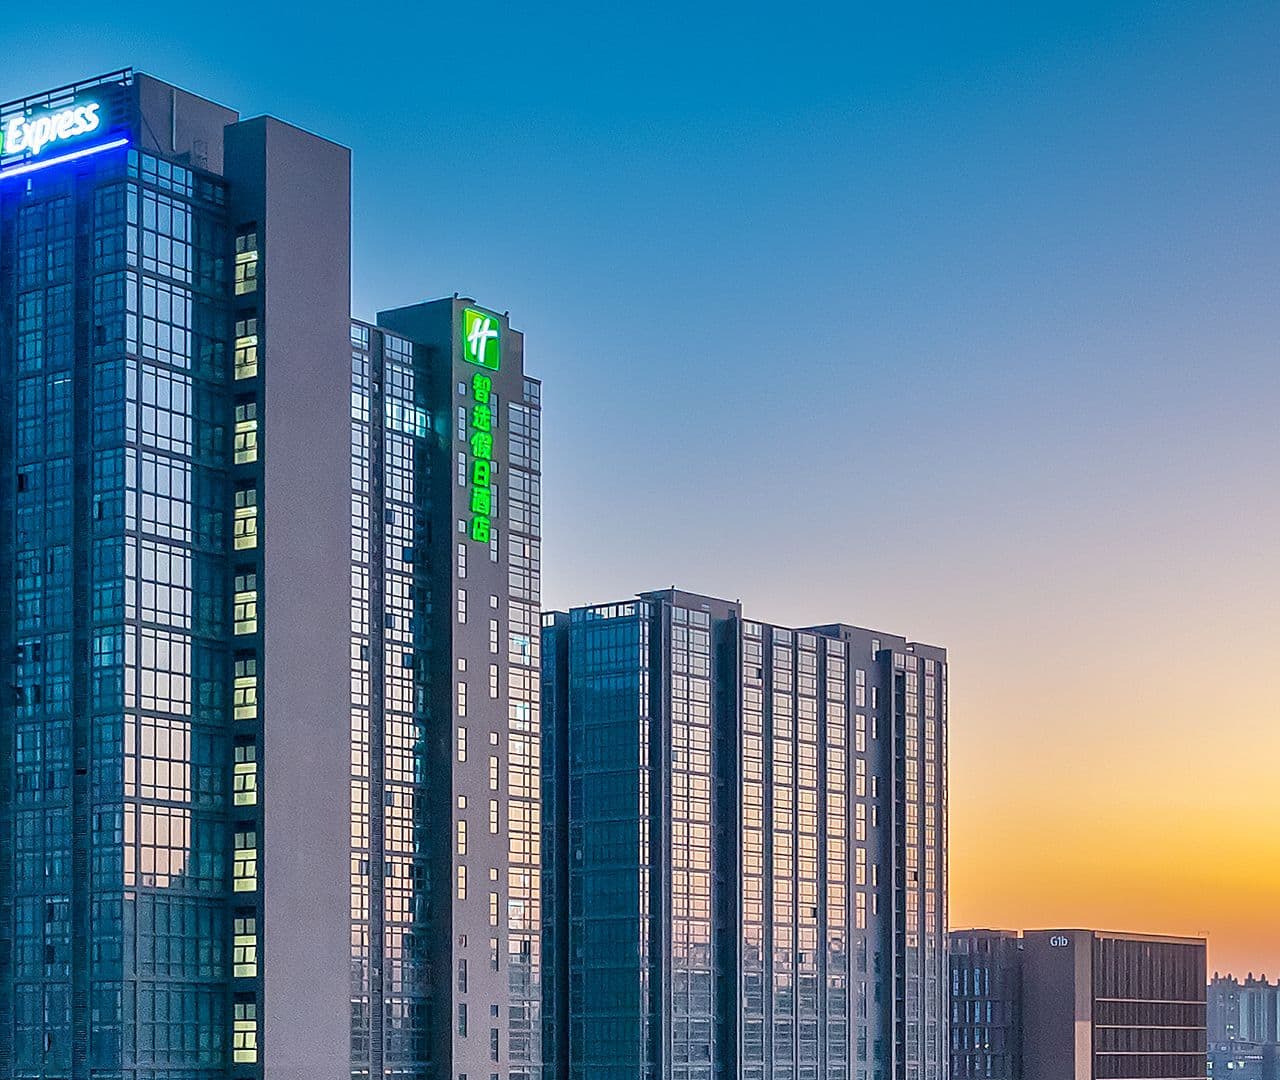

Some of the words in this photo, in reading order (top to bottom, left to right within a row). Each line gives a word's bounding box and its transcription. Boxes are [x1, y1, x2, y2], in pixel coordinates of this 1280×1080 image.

[7, 102, 99, 154] Express
[471, 373, 492, 543] 智选假日酒店
[1050, 935, 1068, 947] G1b
